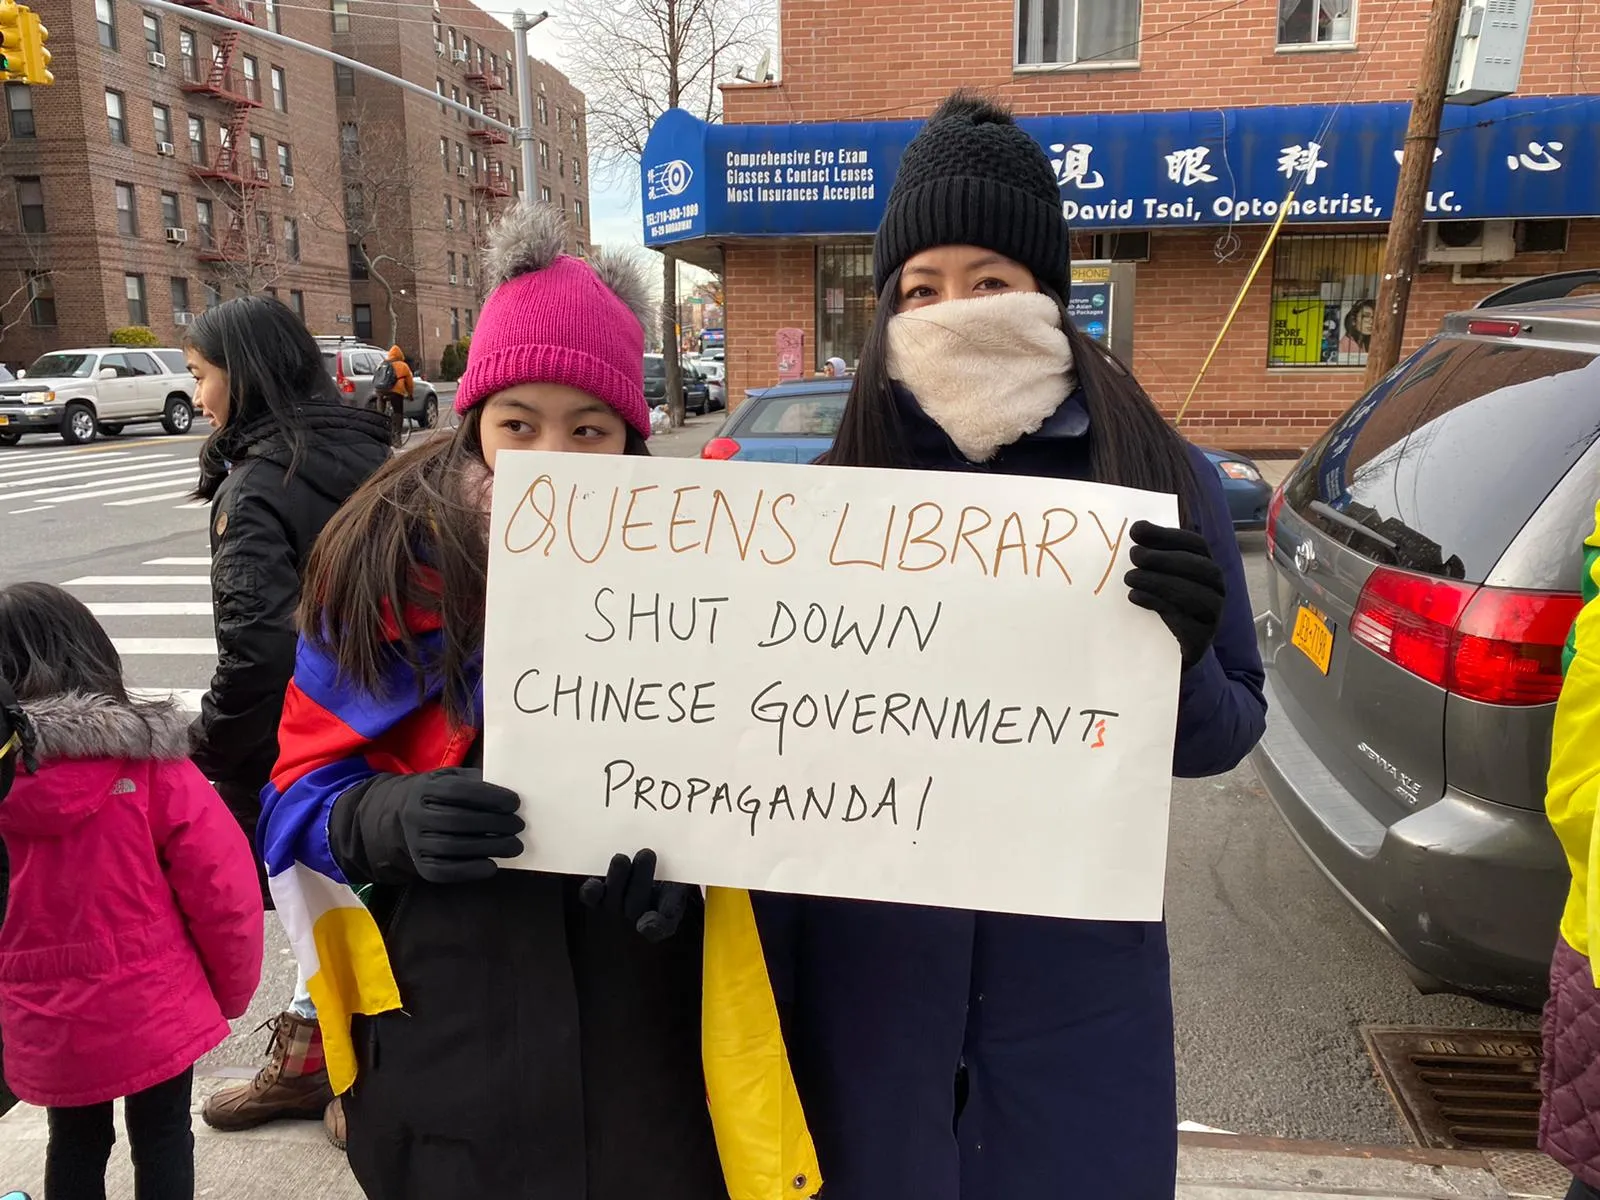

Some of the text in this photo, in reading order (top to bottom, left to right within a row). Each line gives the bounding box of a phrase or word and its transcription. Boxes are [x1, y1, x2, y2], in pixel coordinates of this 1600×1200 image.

[726, 149, 868, 167] Comprehensive Eye Exam
[726, 167, 874, 184] Glasses & Contact Lenses
[727, 184, 875, 202] Most Insurances Accepted
[1063, 199, 1134, 220] David
[1143, 197, 1202, 221] Tsai,
[1213, 191, 1382, 221] Optometrist,
[1072, 268, 1108, 278] PHONE
[505, 475, 1128, 594] QUEENS LIBRARY
[585, 588, 942, 655] SHUT DOWN
[514, 669, 716, 723] CHINESE
[604, 760, 932, 845] PROPAGANDA!
